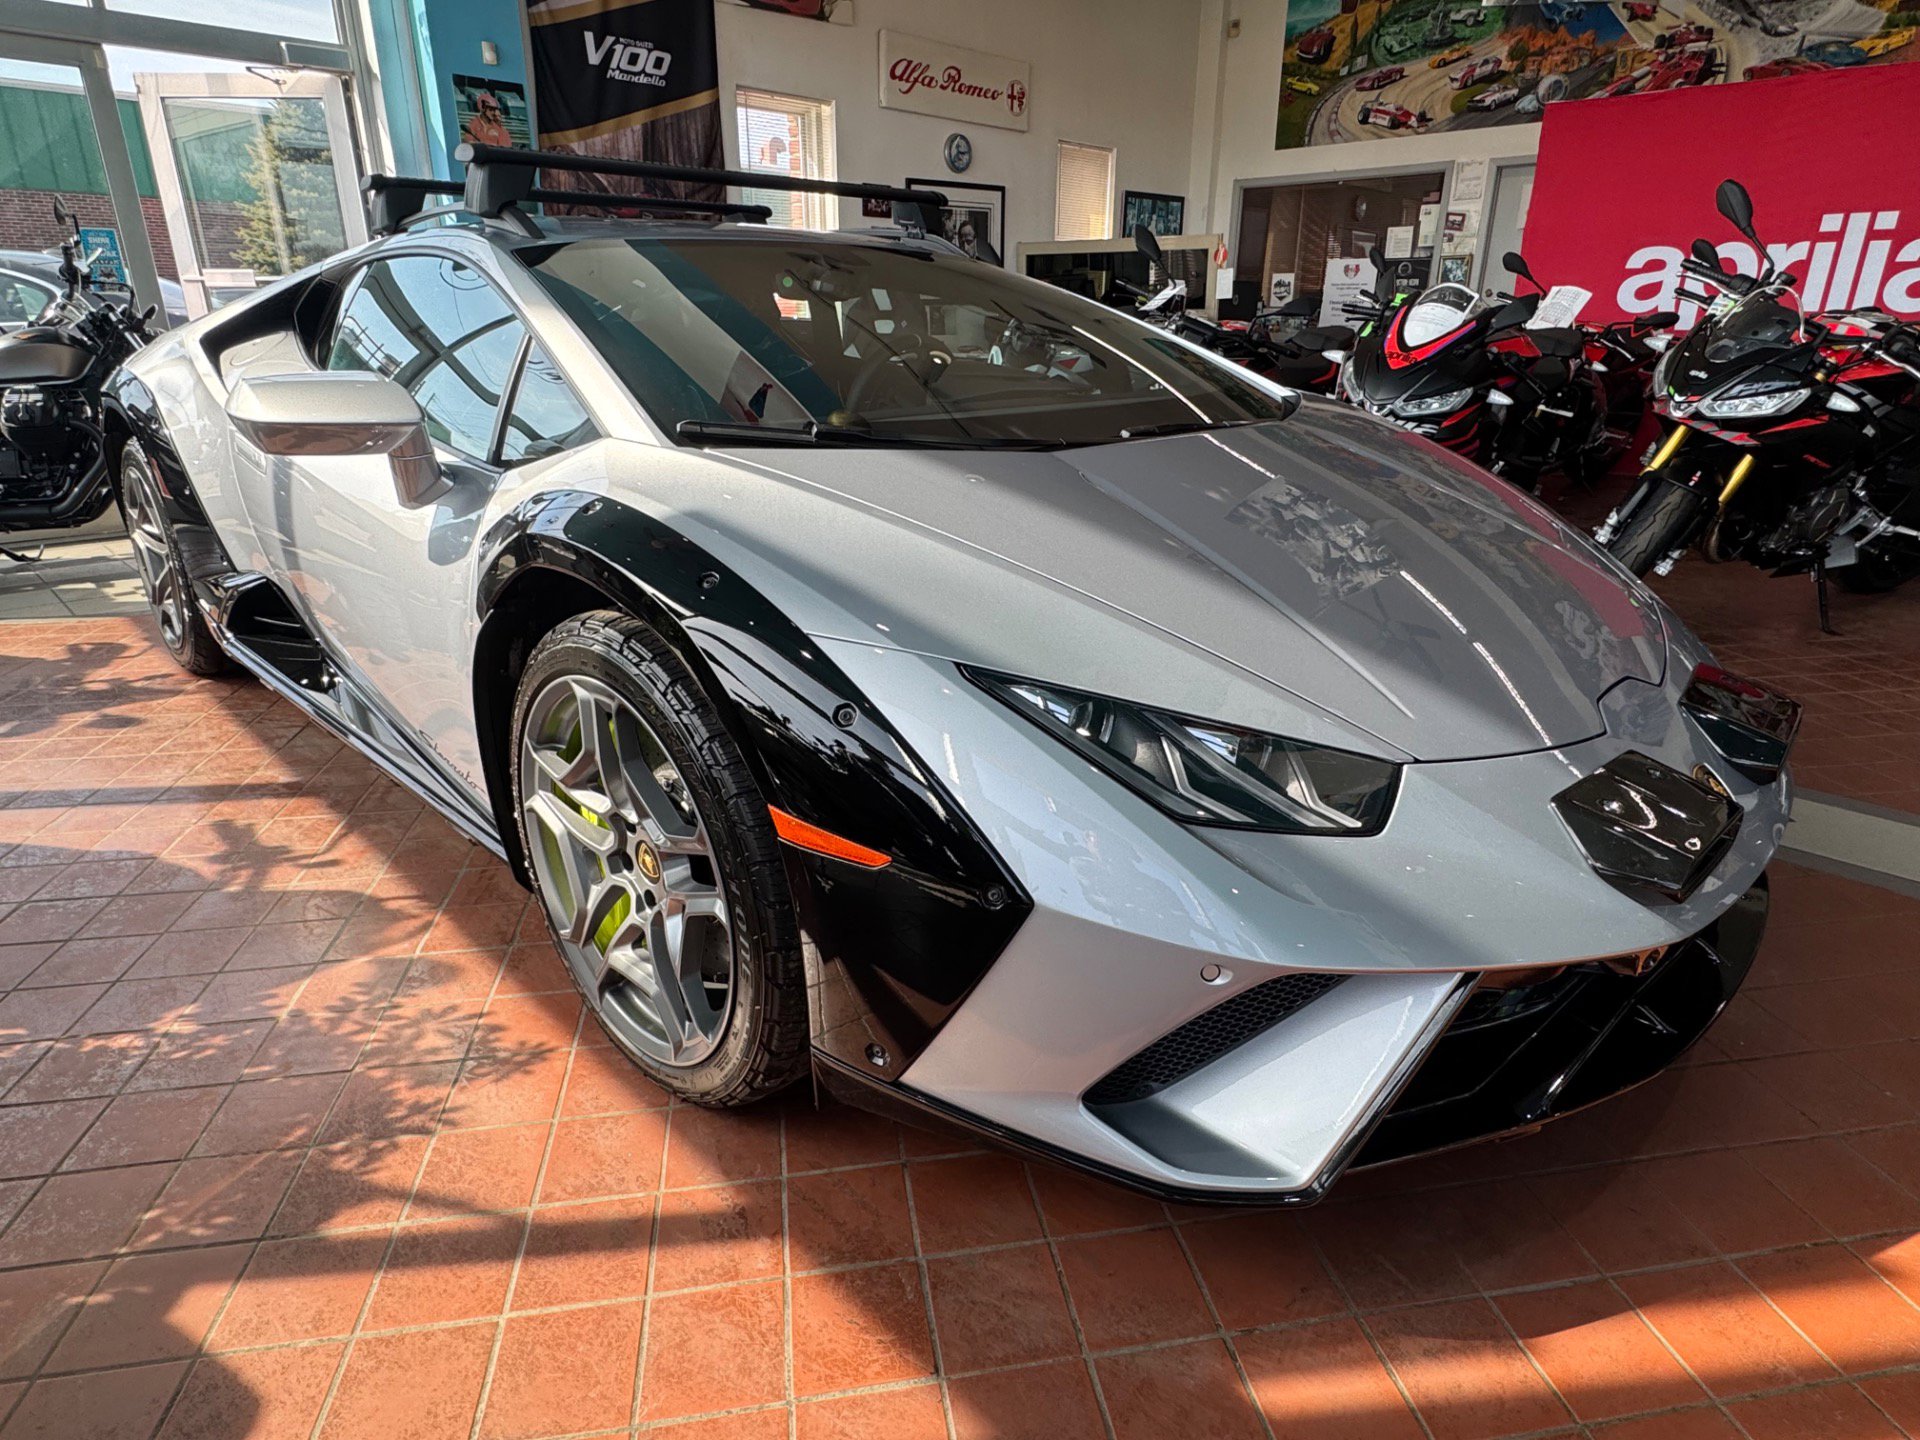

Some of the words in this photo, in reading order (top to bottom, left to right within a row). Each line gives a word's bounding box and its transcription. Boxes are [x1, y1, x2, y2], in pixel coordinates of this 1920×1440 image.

[583, 30, 672, 76] V100
[606, 69, 667, 87] Mandello
[889, 58, 939, 95] Alfa
[939, 65, 1004, 101] Romeo
